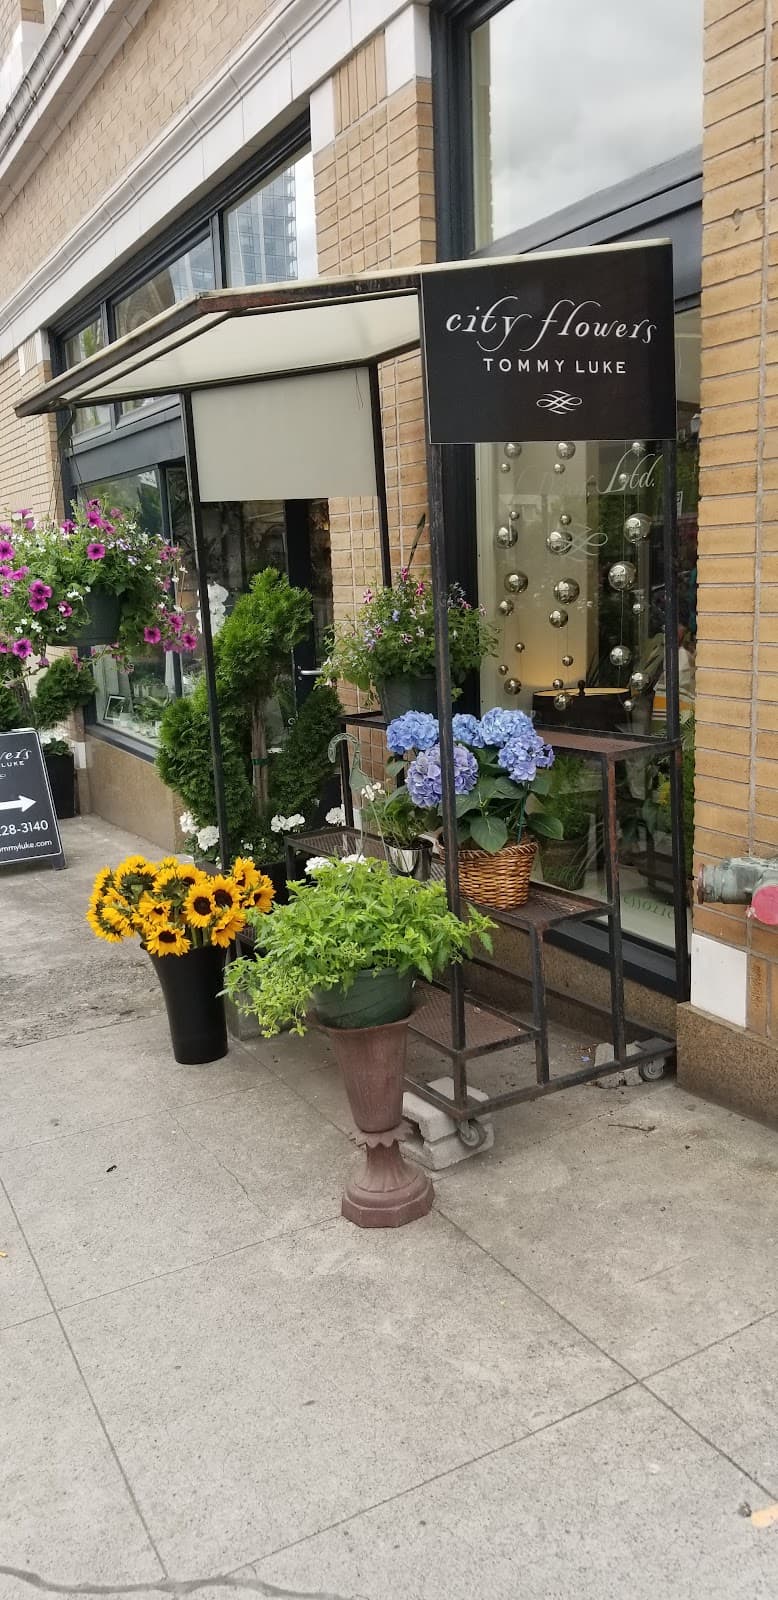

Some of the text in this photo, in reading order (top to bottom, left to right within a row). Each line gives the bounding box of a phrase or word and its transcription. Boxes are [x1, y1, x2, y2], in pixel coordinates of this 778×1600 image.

[446, 295, 657, 351] city flowers
[483, 358, 627, 374] TOMMY LUKE
[1, 760, 25, 768] LUKE
[0, 819, 49, 837] 28-3140
